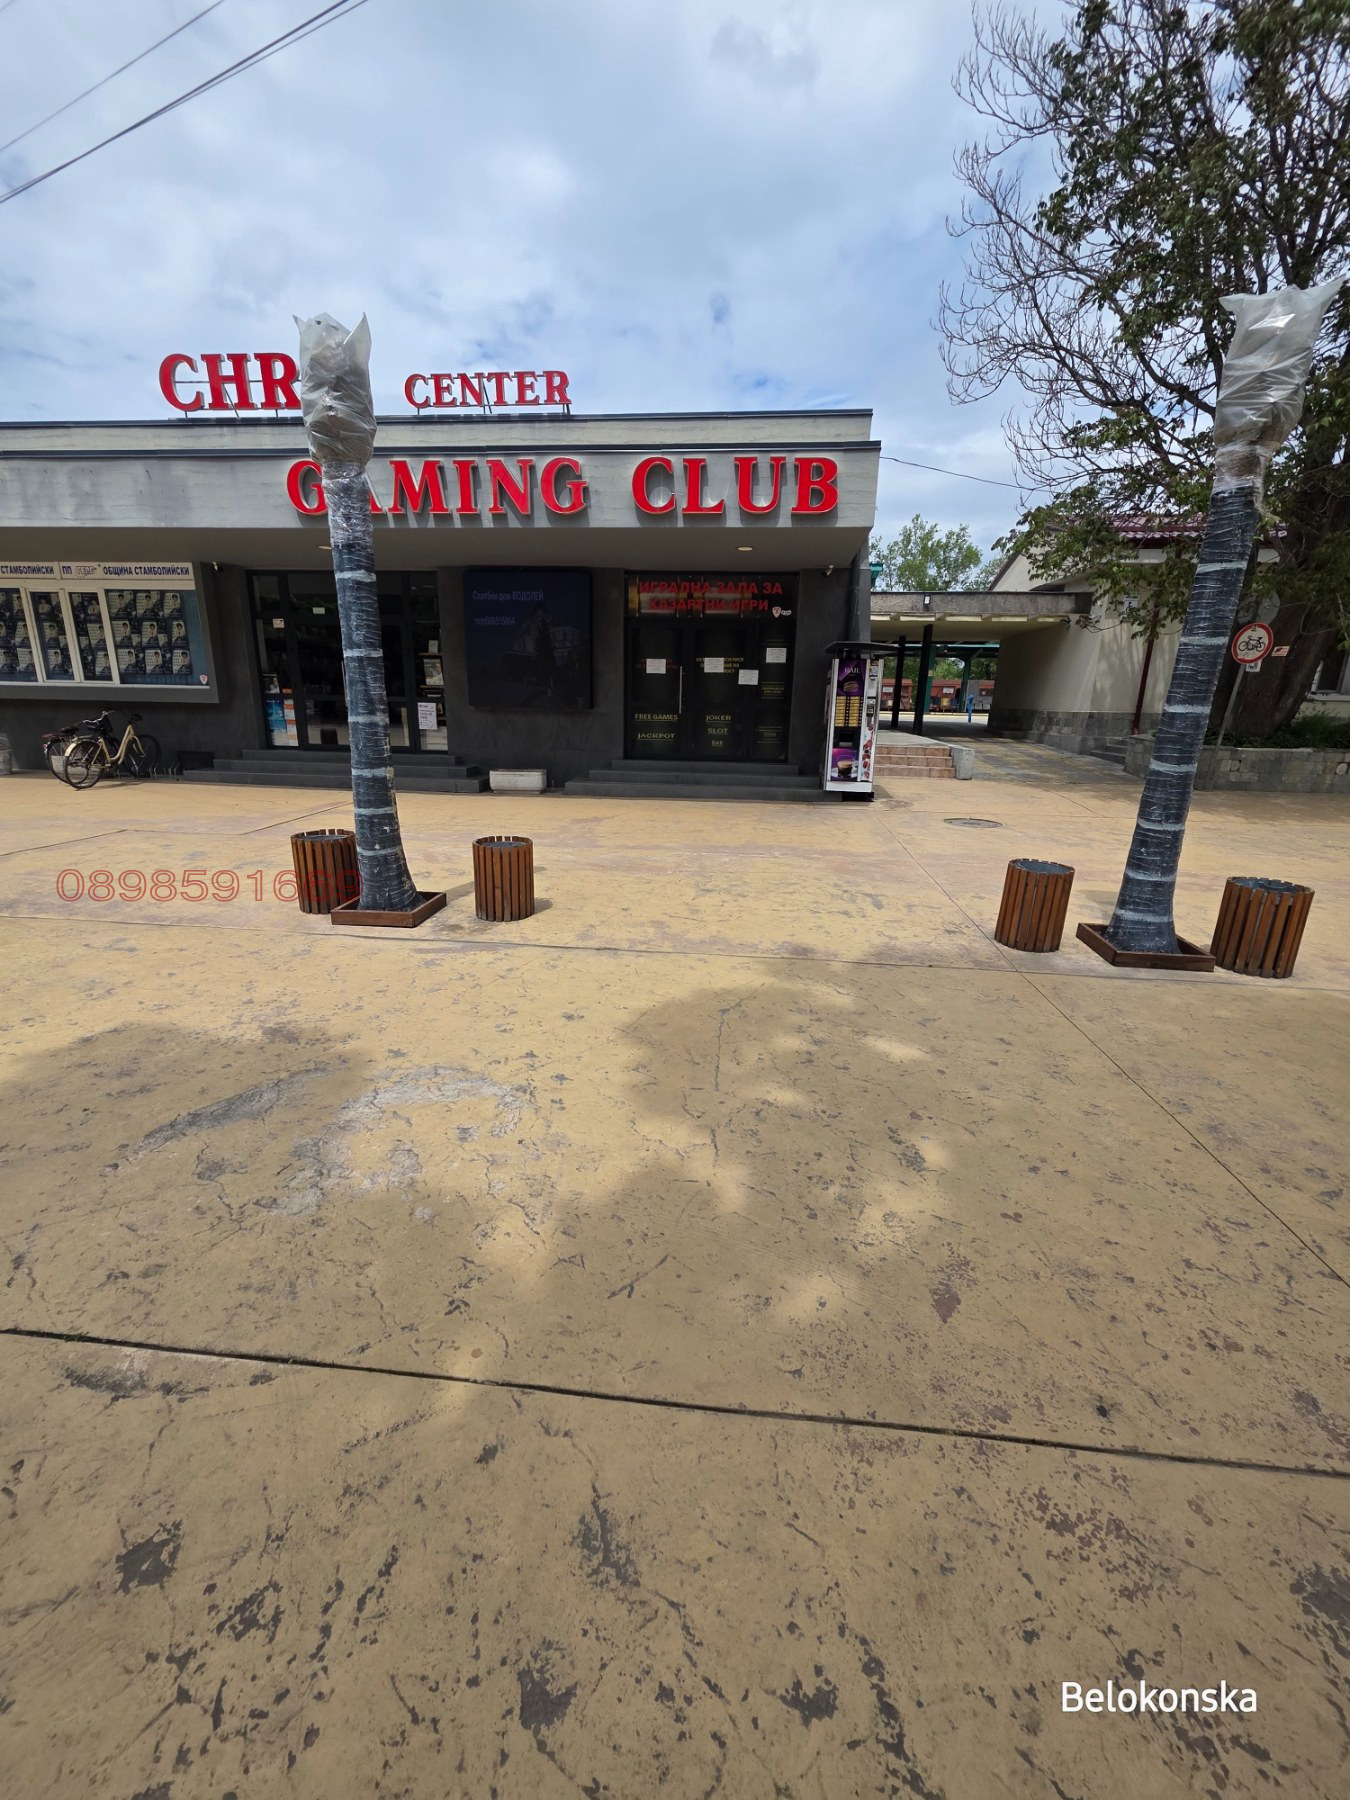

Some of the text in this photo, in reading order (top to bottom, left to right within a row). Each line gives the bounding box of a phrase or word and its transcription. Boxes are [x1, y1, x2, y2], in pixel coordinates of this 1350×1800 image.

[404, 371, 572, 409] CENTER
[631, 456, 839, 515] CLUB
[103, 565, 133, 576] ОБЩИНА
[135, 564, 190, 576] СТАМБОЛИЙСКИ
[639, 582, 783, 595] ИГРАЛНА ЗАЛА ЗА
[731, 599, 769, 611] ИГРИ
[634, 713, 679, 721] FREE GAMES
